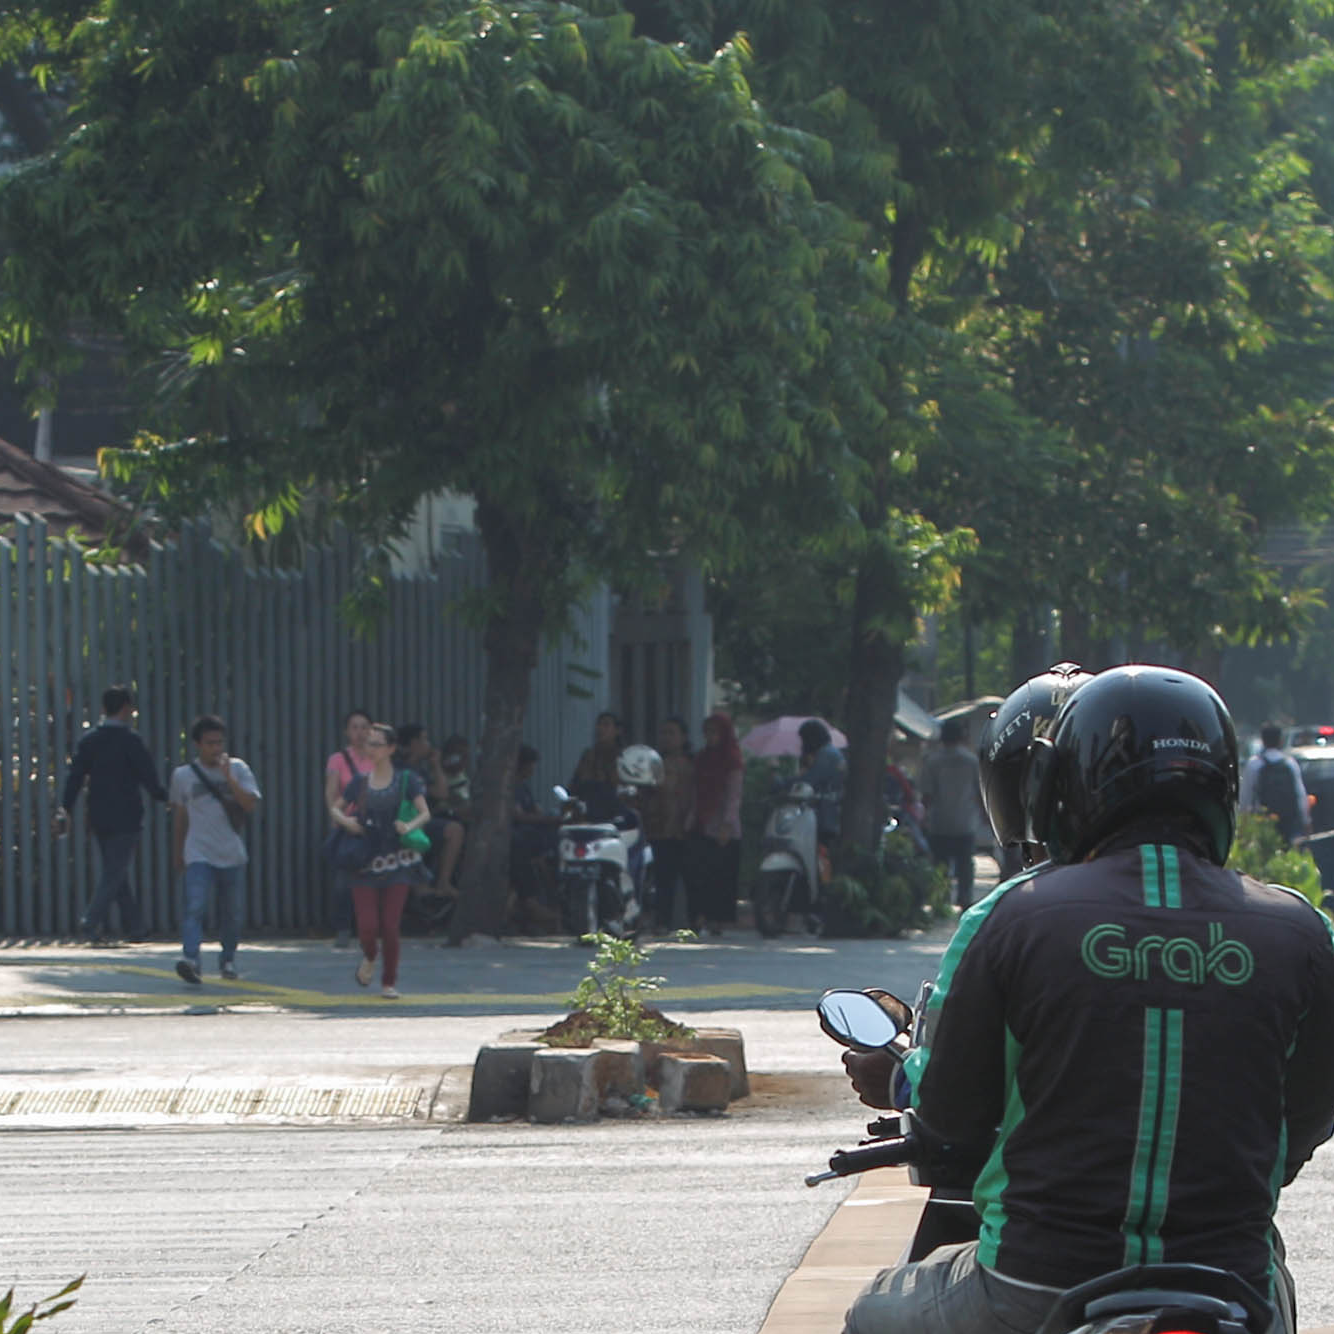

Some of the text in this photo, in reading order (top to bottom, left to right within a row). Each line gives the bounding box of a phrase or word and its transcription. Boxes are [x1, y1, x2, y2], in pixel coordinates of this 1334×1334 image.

[988, 709, 1031, 761] SAFETY
[1153, 737, 1211, 753] HONDA
[1081, 923, 1256, 987] Grab
